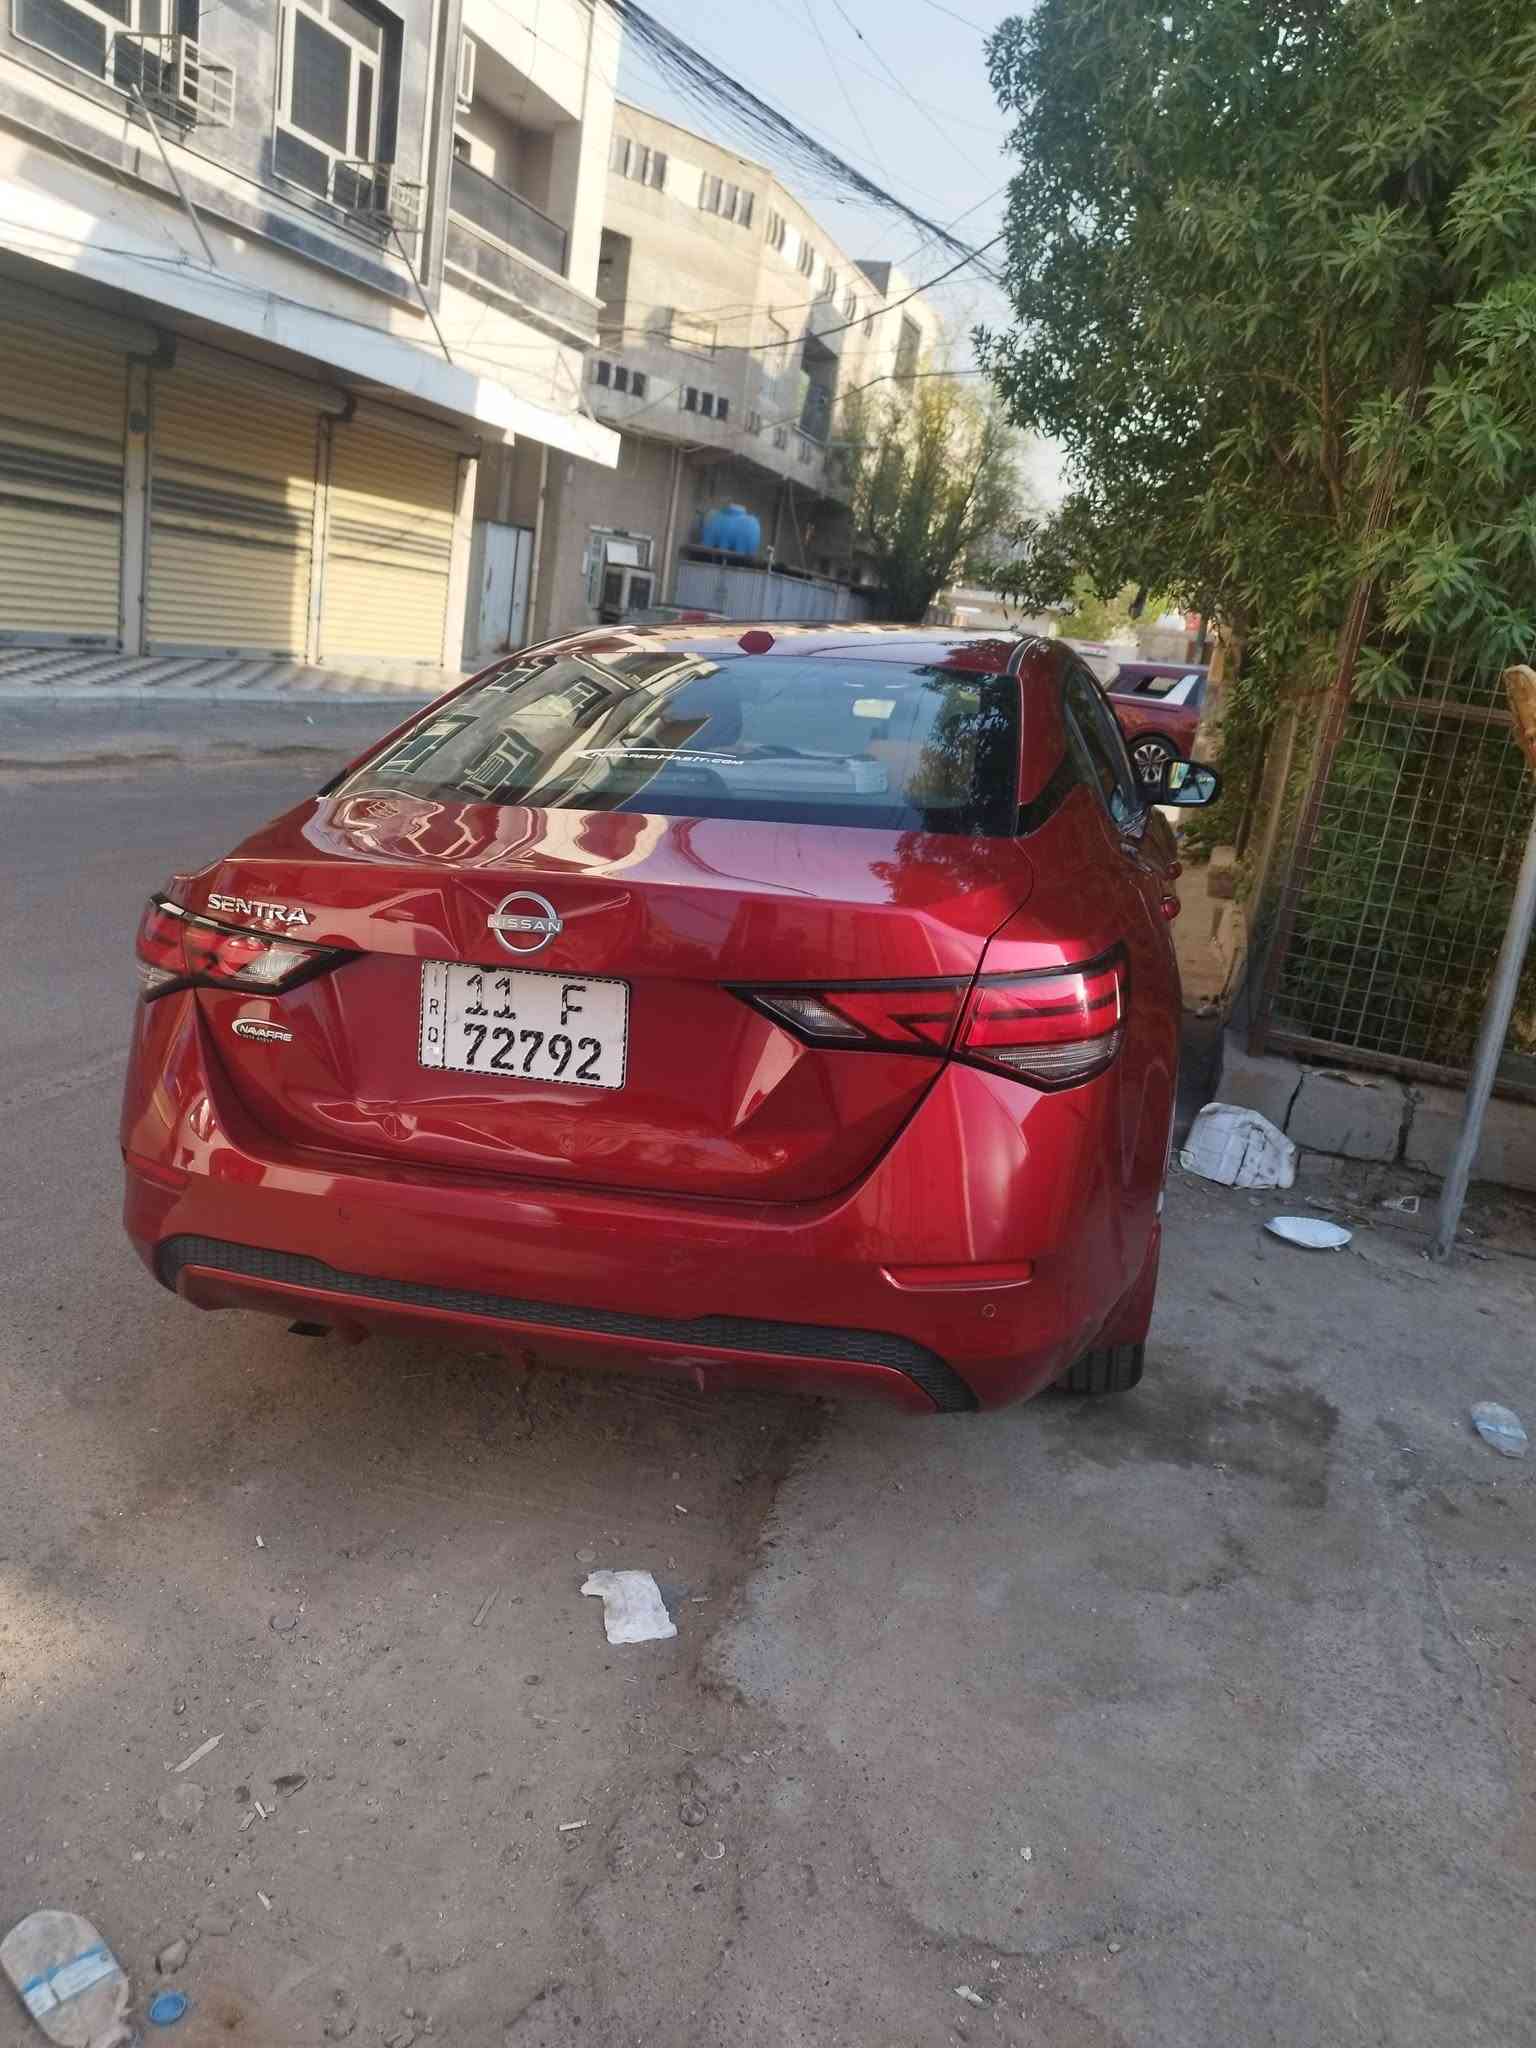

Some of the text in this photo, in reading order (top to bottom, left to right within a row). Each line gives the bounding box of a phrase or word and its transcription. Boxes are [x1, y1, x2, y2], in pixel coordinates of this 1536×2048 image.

[208, 894, 309, 925] SENTRA
[488, 916, 561, 932] NISSAN
[464, 974, 586, 1026] 11 F
[464, 1022, 602, 1081] 72792
